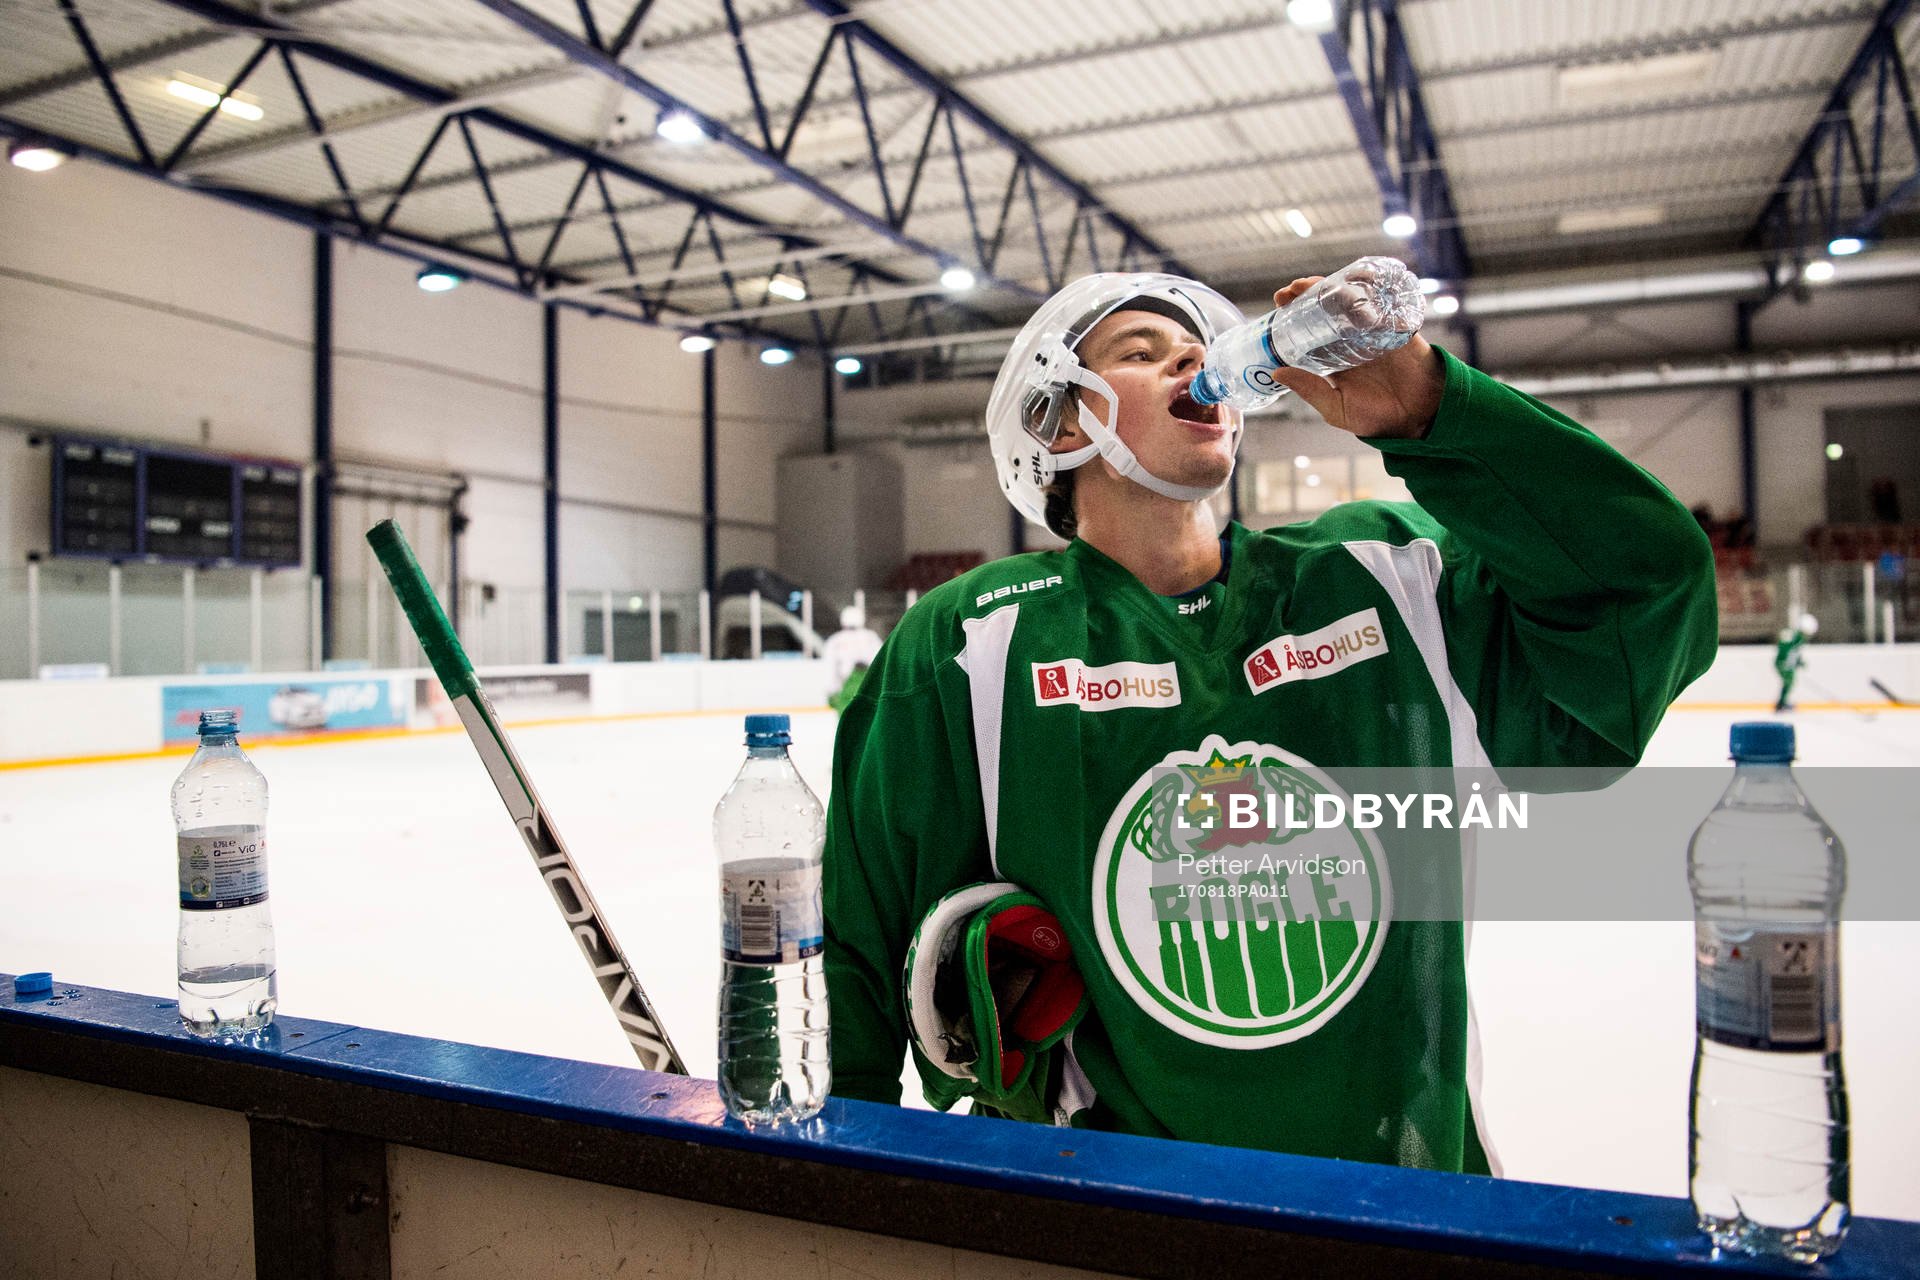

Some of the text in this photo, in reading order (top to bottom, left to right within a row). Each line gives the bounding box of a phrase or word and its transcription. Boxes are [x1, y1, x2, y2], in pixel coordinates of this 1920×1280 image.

[1032, 451, 1043, 486] SHL
[1178, 595, 1211, 614] SHL
[1284, 625, 1380, 671] ÅSBOHUS
[516, 803, 671, 1072] VAPOR
[1149, 856, 1359, 1018] RÖGLE
